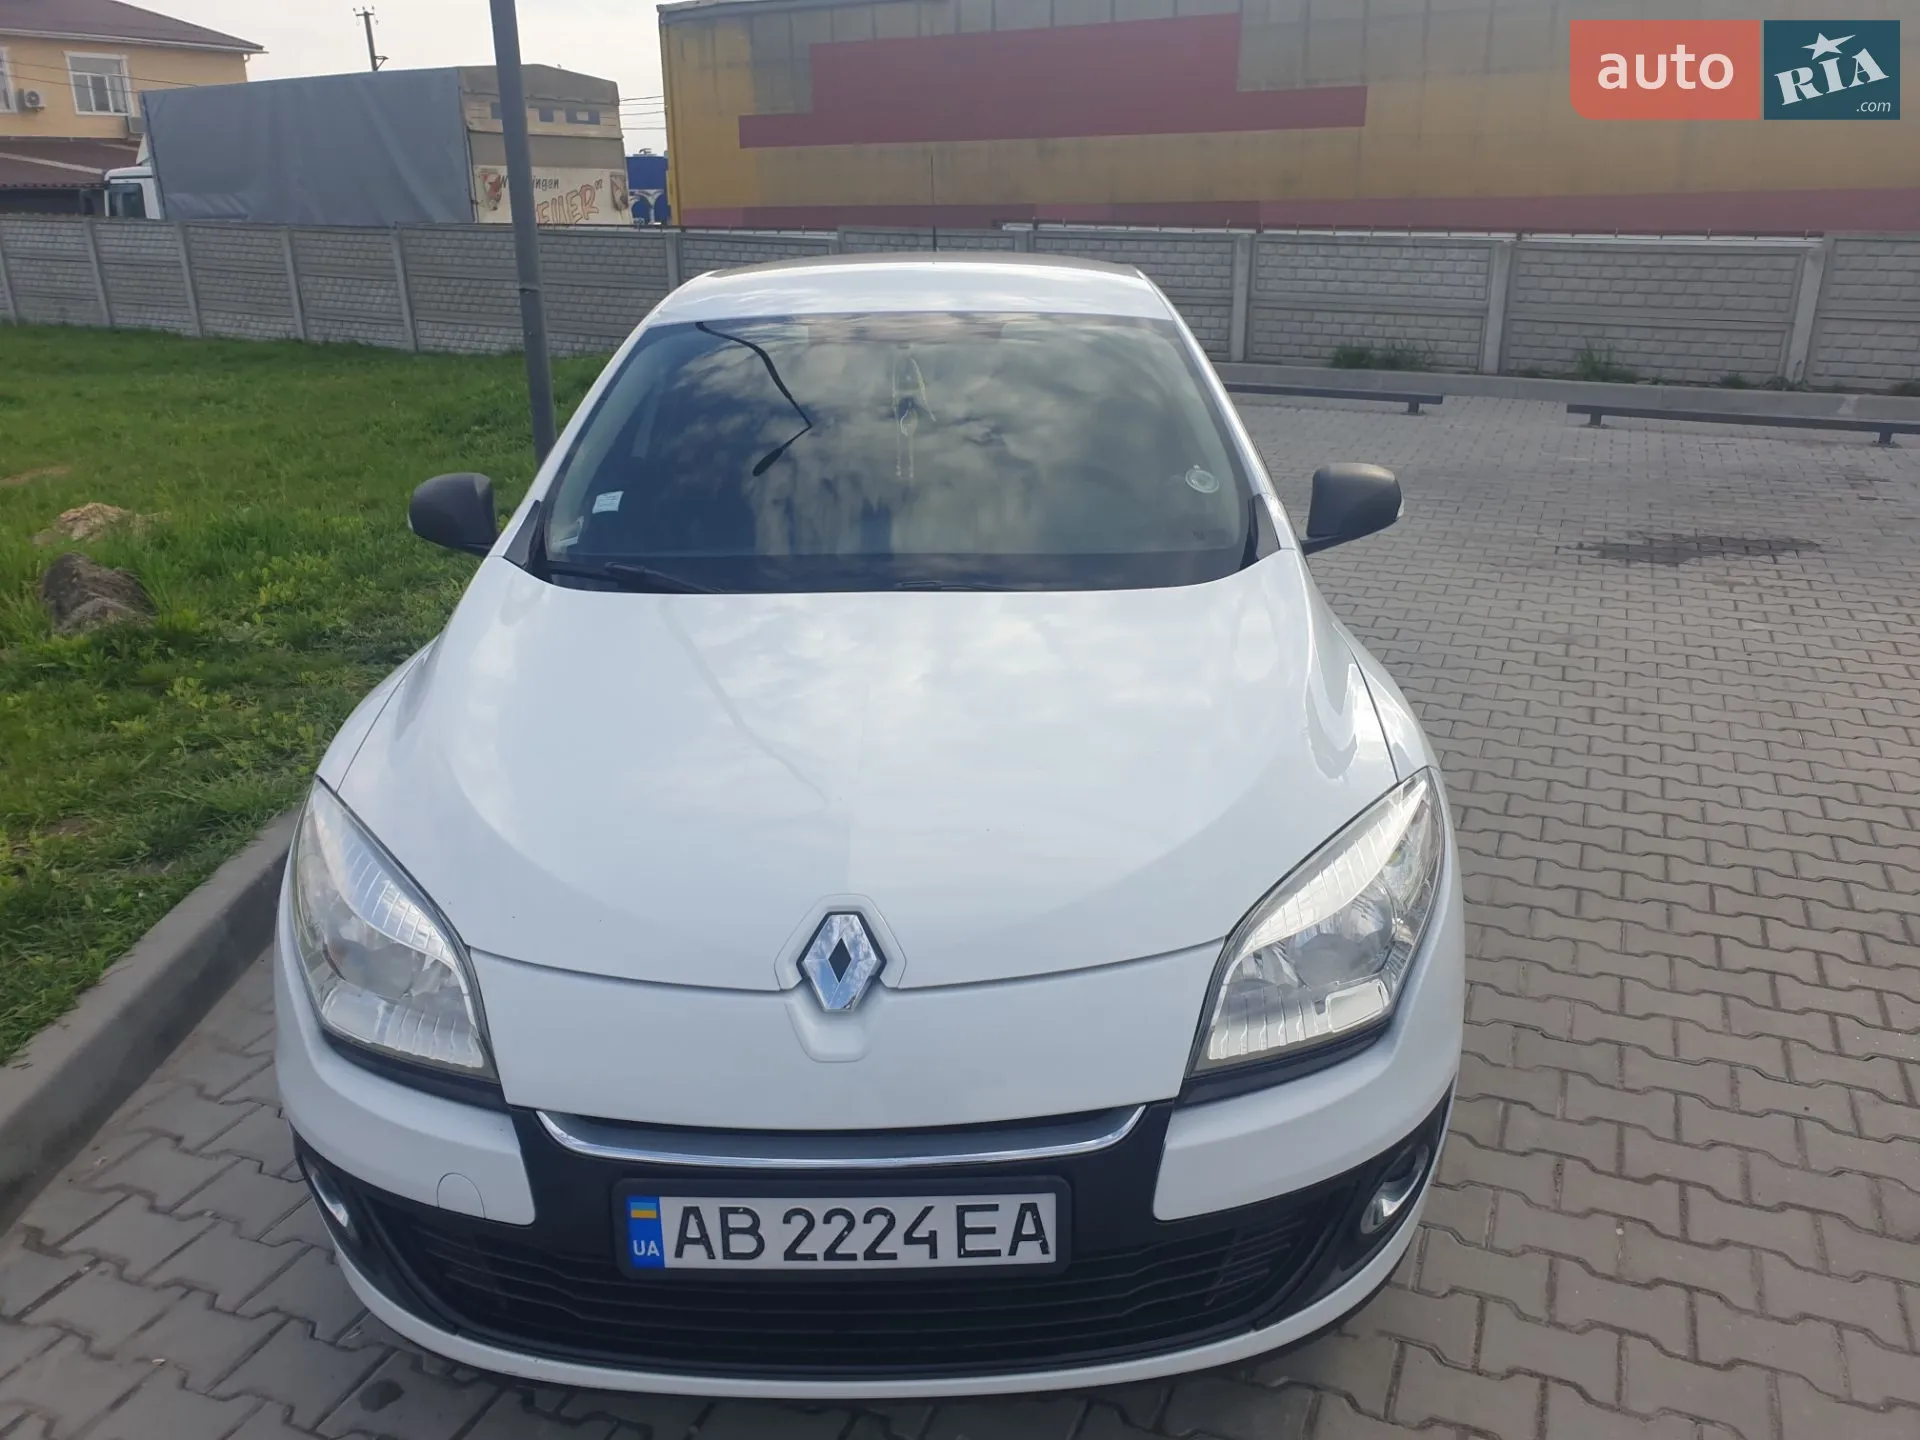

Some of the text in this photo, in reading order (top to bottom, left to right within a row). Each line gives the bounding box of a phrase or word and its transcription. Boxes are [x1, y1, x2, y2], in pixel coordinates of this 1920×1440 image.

[633, 1239, 660, 1257] UA
[674, 1202, 1050, 1262] AB 2224 EA
